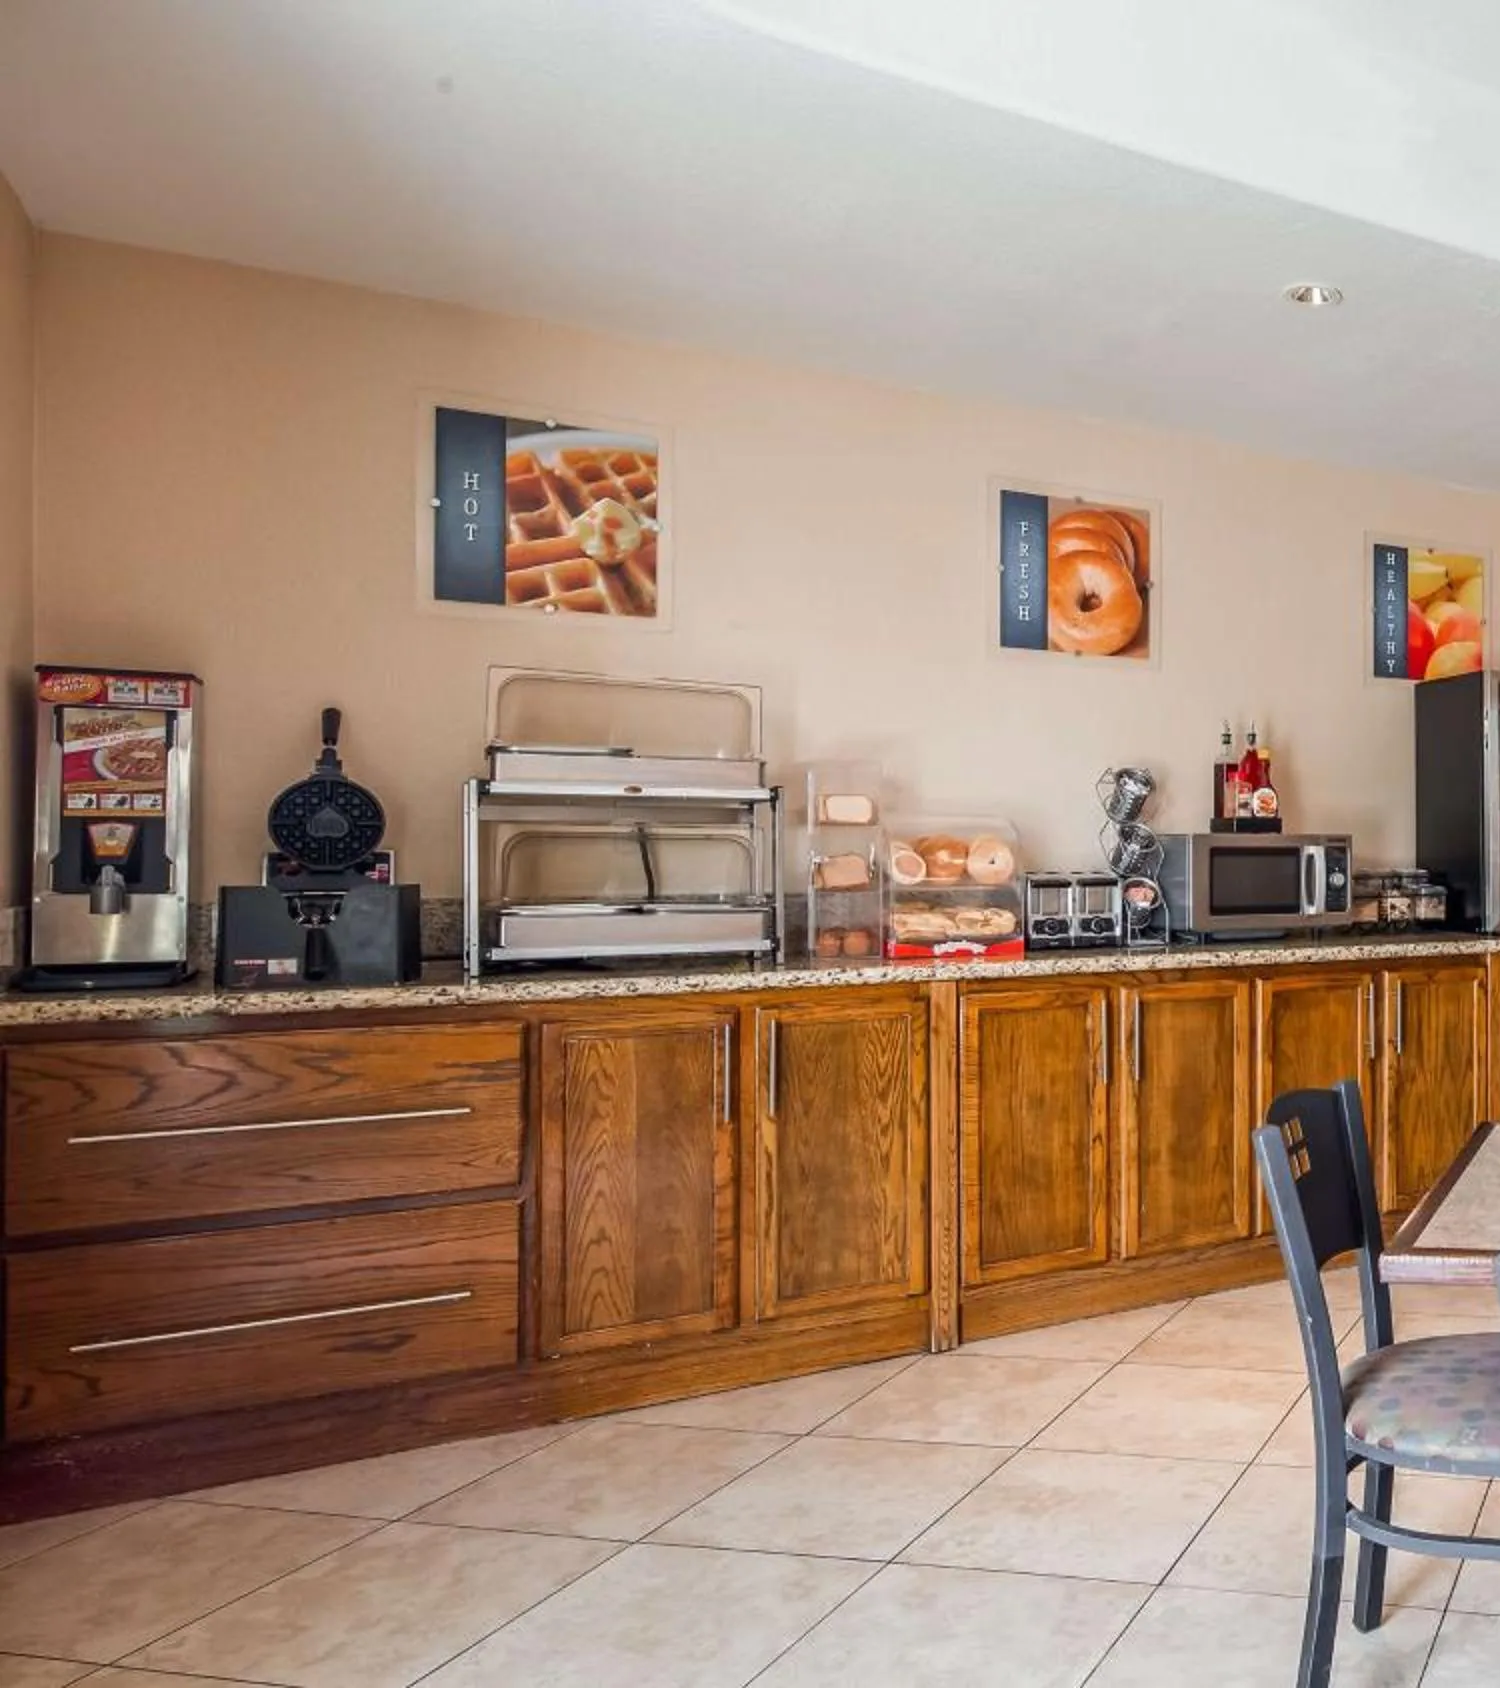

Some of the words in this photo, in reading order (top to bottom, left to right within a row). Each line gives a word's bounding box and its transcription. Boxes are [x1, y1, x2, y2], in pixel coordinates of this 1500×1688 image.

[463, 472, 480, 541] HOT
[1017, 521, 1031, 621] FRESH
[1386, 552, 1396, 673] HEALTHY
